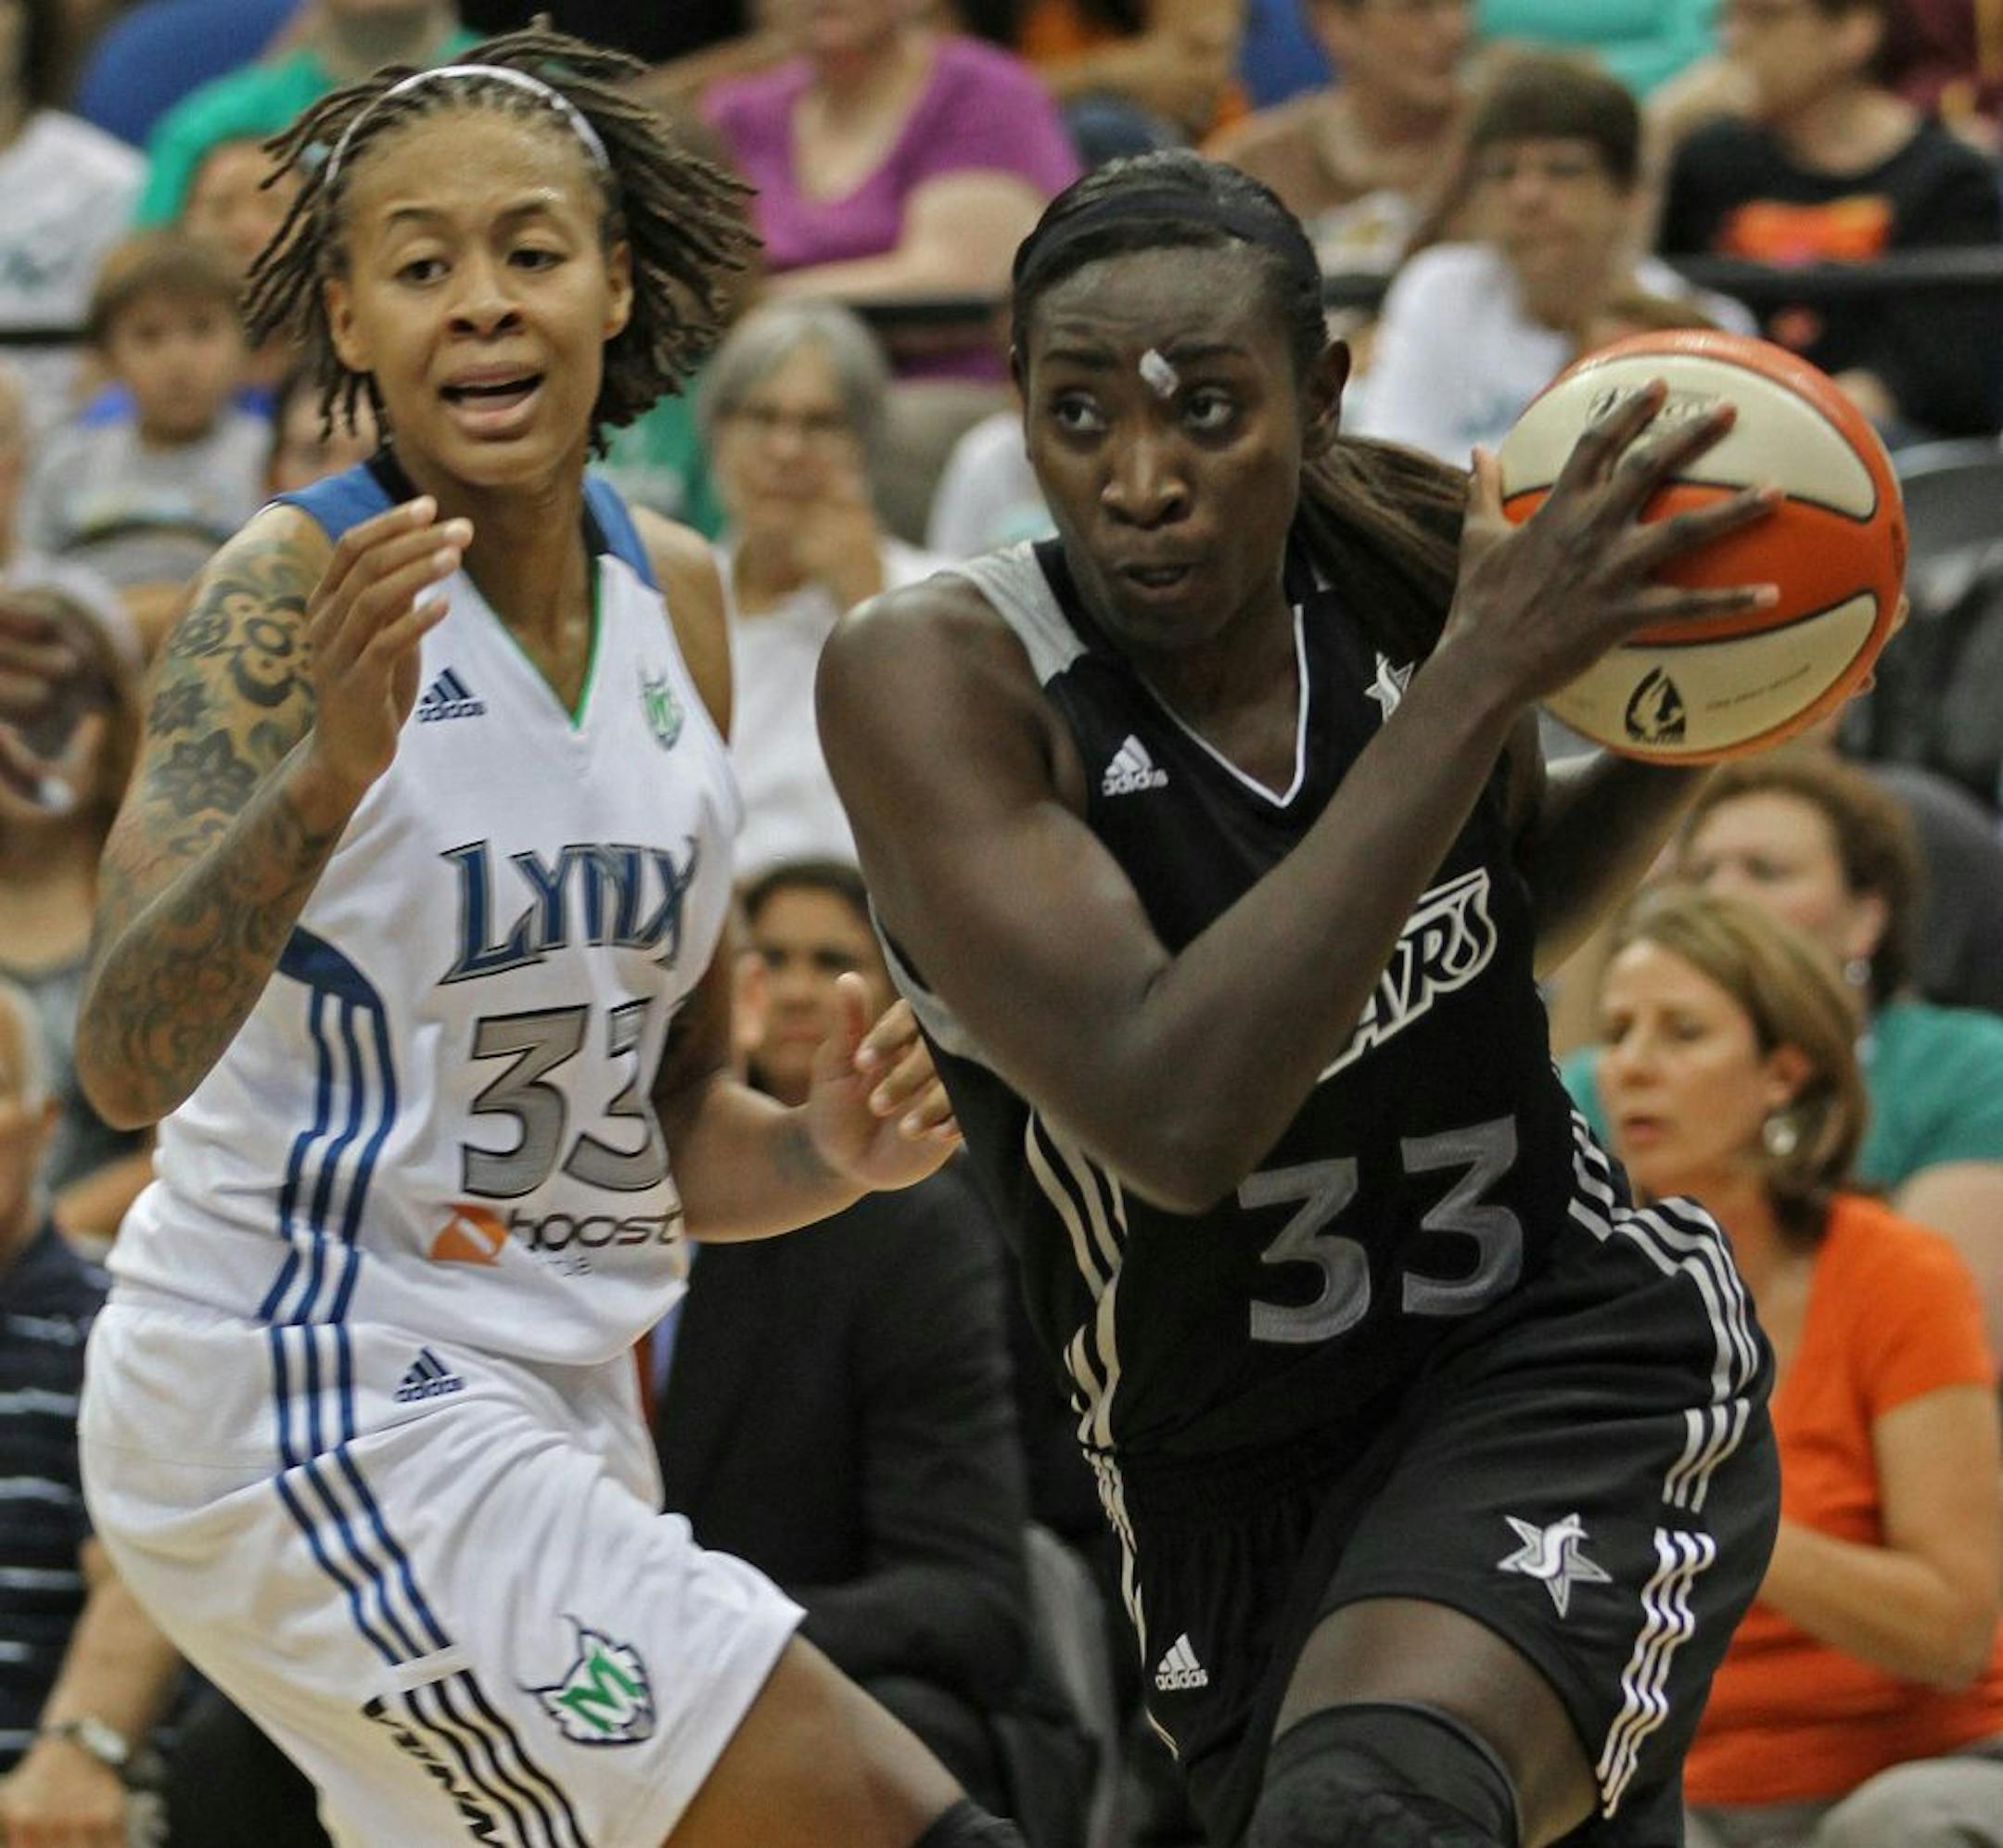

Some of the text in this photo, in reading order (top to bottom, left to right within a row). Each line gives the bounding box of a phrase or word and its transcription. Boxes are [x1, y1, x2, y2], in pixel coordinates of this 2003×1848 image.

[1102, 769, 1168, 797] adidas
[435, 835, 698, 986] LYNX
[461, 997, 670, 1199] 33
[1238, 1115, 1524, 1344] 33
[1155, 1668, 1208, 1690] adidas
